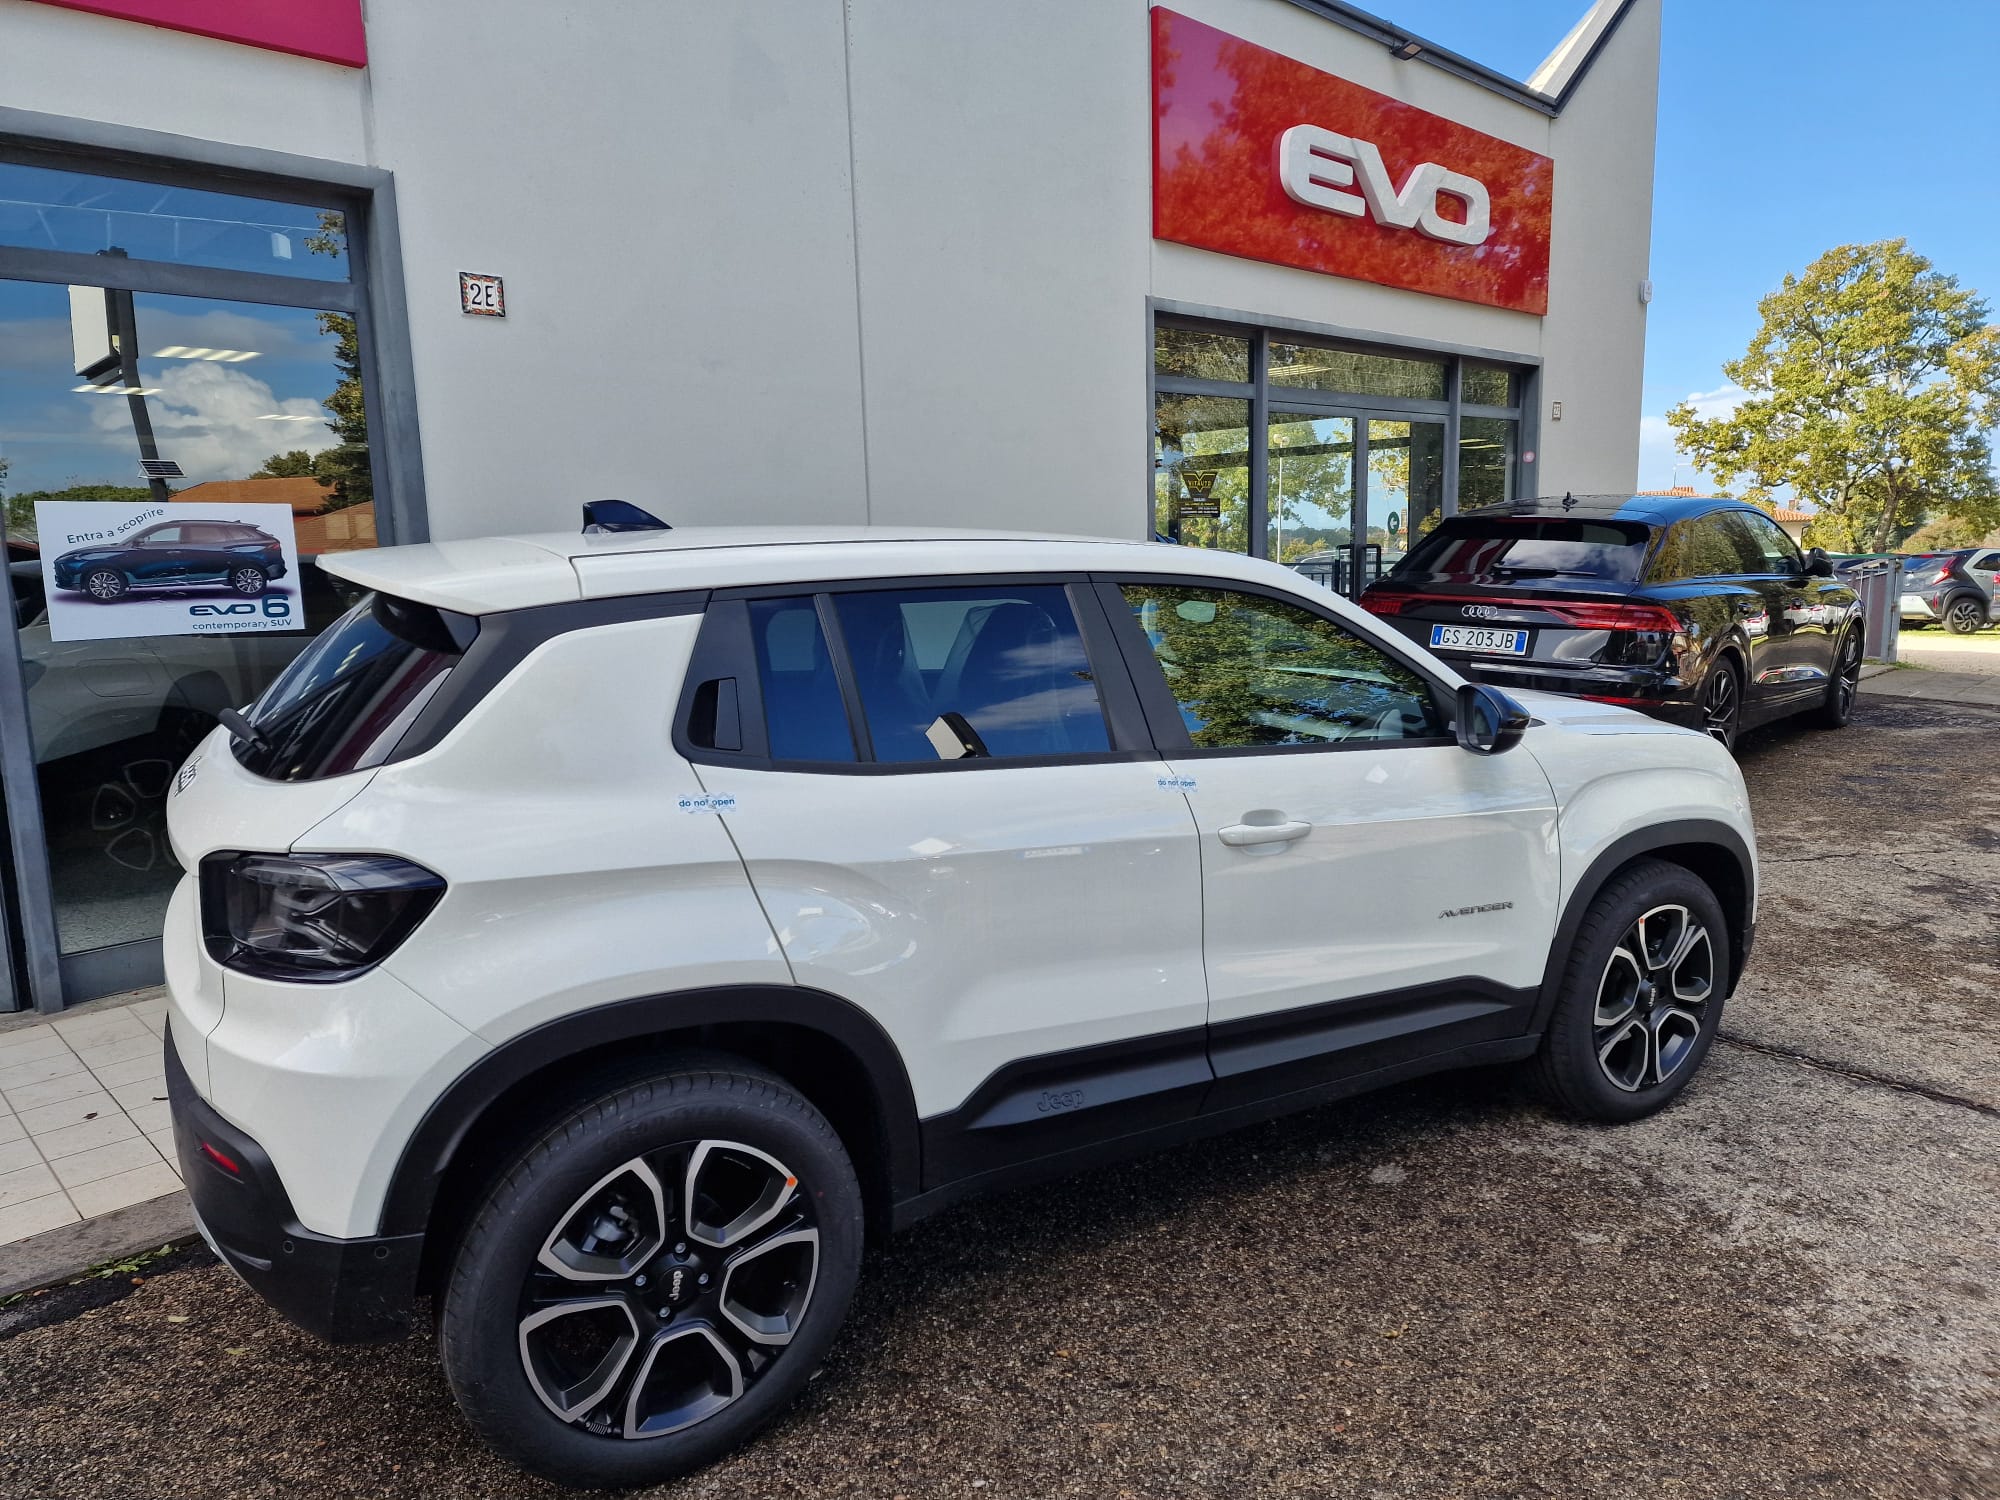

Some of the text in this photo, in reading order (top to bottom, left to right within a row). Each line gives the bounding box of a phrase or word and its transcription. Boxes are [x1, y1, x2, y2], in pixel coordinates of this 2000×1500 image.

[1279, 124, 1490, 246] EVO
[470, 283, 495, 307] 2E
[67, 508, 164, 544] Entra a scoprire
[189, 594, 290, 618] EVO 6
[192, 618, 292, 630] contemporary SUV
[679, 799, 735, 807] do not open
[1439, 901, 1514, 919] AVENGER
[1037, 1090, 1084, 1112] Jeep
[669, 1270, 684, 1301] Jeep
